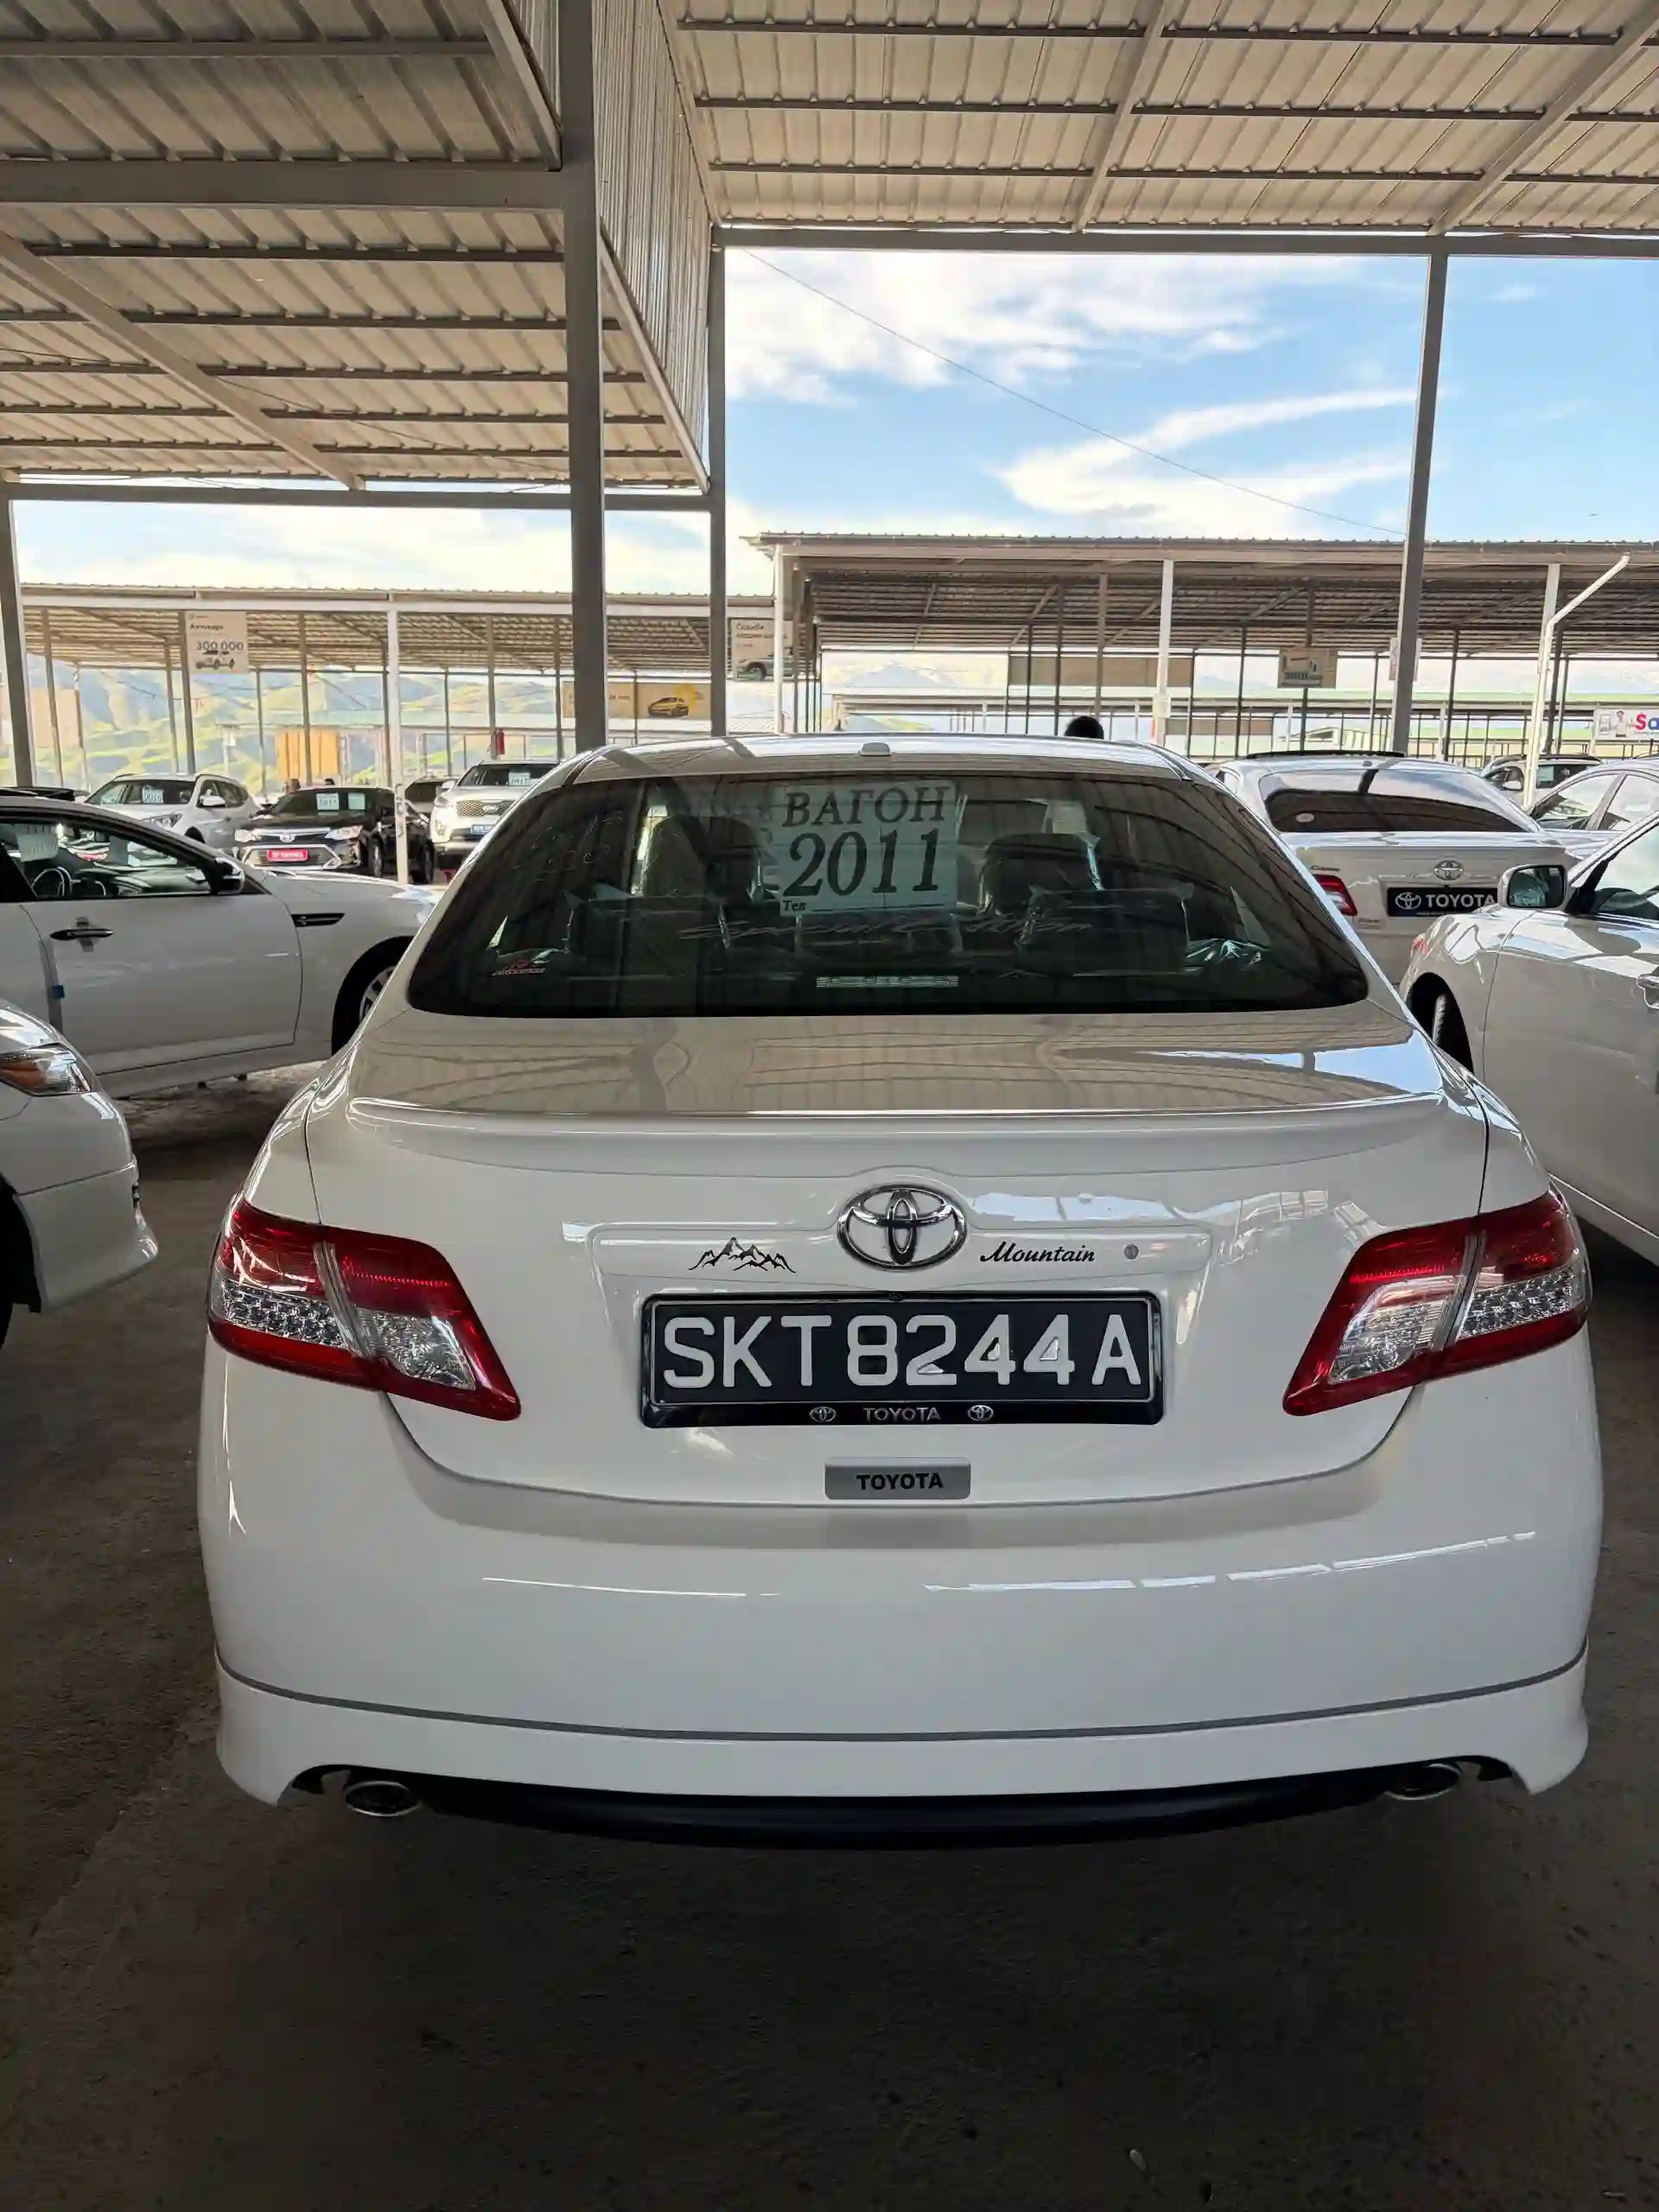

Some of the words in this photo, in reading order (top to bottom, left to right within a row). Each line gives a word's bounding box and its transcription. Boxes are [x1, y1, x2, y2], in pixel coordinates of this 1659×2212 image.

[195, 641, 219, 652] 300
[782, 786, 950, 827] ВАГОН
[783, 828, 939, 897] 2011
[1427, 893, 1496, 908] TOYOTA
[980, 1241, 1096, 1263] Mountain
[864, 1407, 941, 1422] TOYOTA
[856, 1473, 944, 1491] TOYOTA
